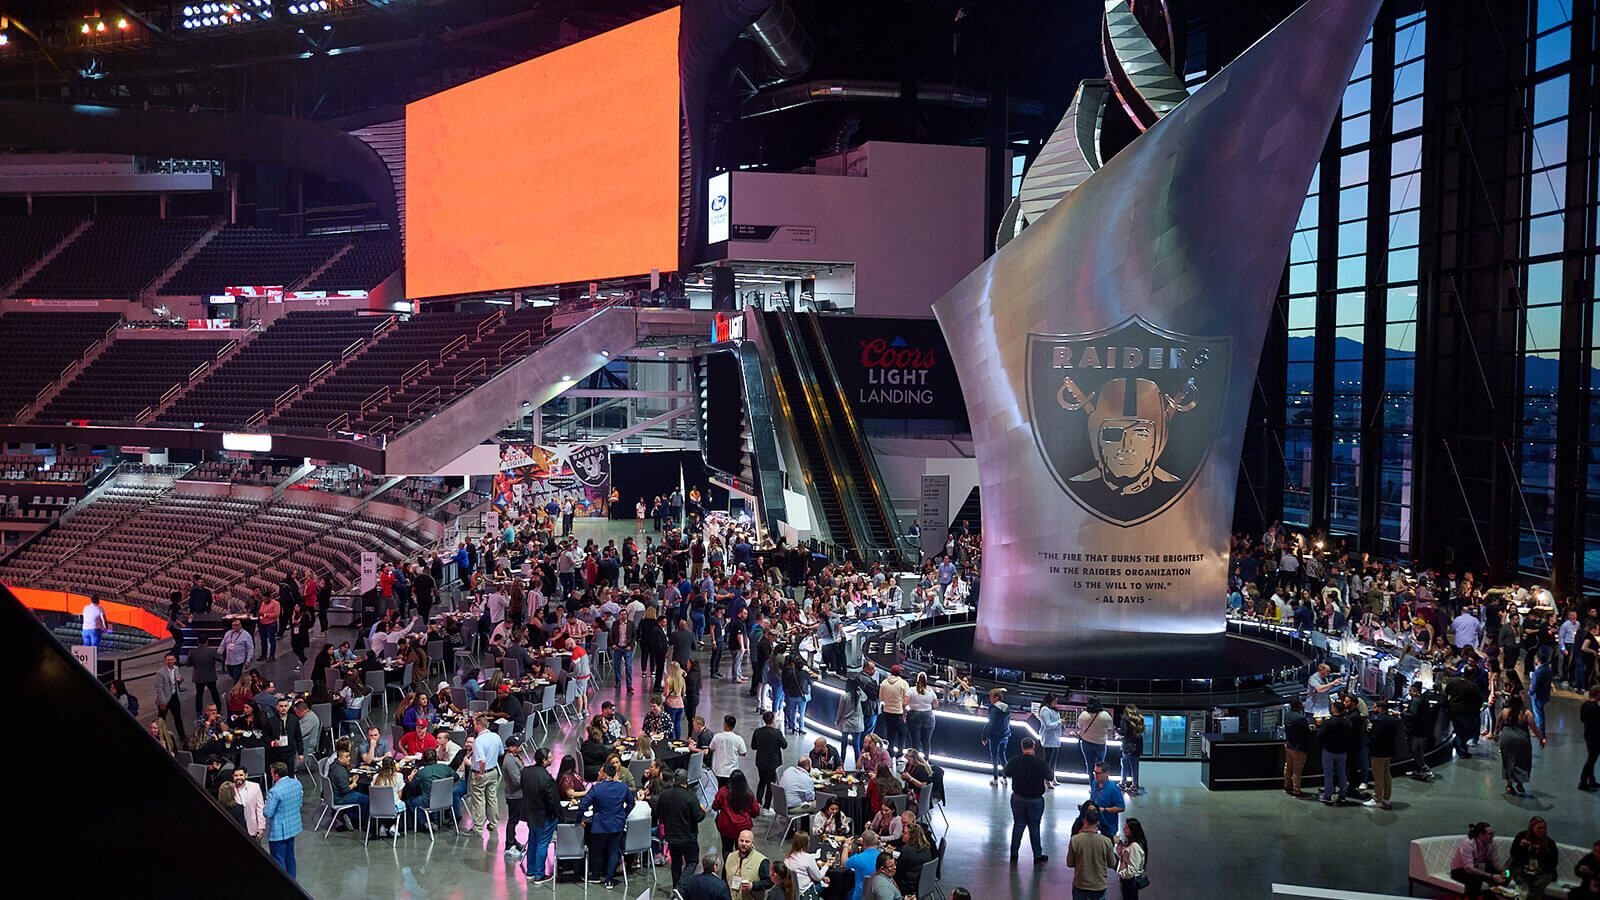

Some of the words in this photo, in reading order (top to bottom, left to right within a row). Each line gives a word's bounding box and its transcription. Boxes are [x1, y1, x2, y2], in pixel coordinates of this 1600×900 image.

[861, 338, 936, 369] Coors
[1052, 346, 1210, 369] RAIDERS
[869, 368, 929, 385] LIGHT
[860, 388, 934, 404] LANDING
[1038, 552, 1061, 560] "THE
[1063, 553, 1082, 561] FIRE
[1085, 554, 1108, 562] THAT
[1111, 554, 1141, 563] BURNS
[1163, 554, 1203, 562] BRIGHTEST
[1050, 566, 1060, 574] IN
[1063, 567, 1079, 575] THE
[1082, 568, 1122, 576] RAIDERS
[1125, 568, 1191, 576] ORGANIZATION
[1073, 581, 1082, 589] IS
[1085, 581, 1102, 589] THE
[1105, 582, 1127, 590] WILL
[1130, 582, 1142, 590] TO
[1102, 596, 1115, 604] AL
[1117, 596, 1145, 604] DAVIS
